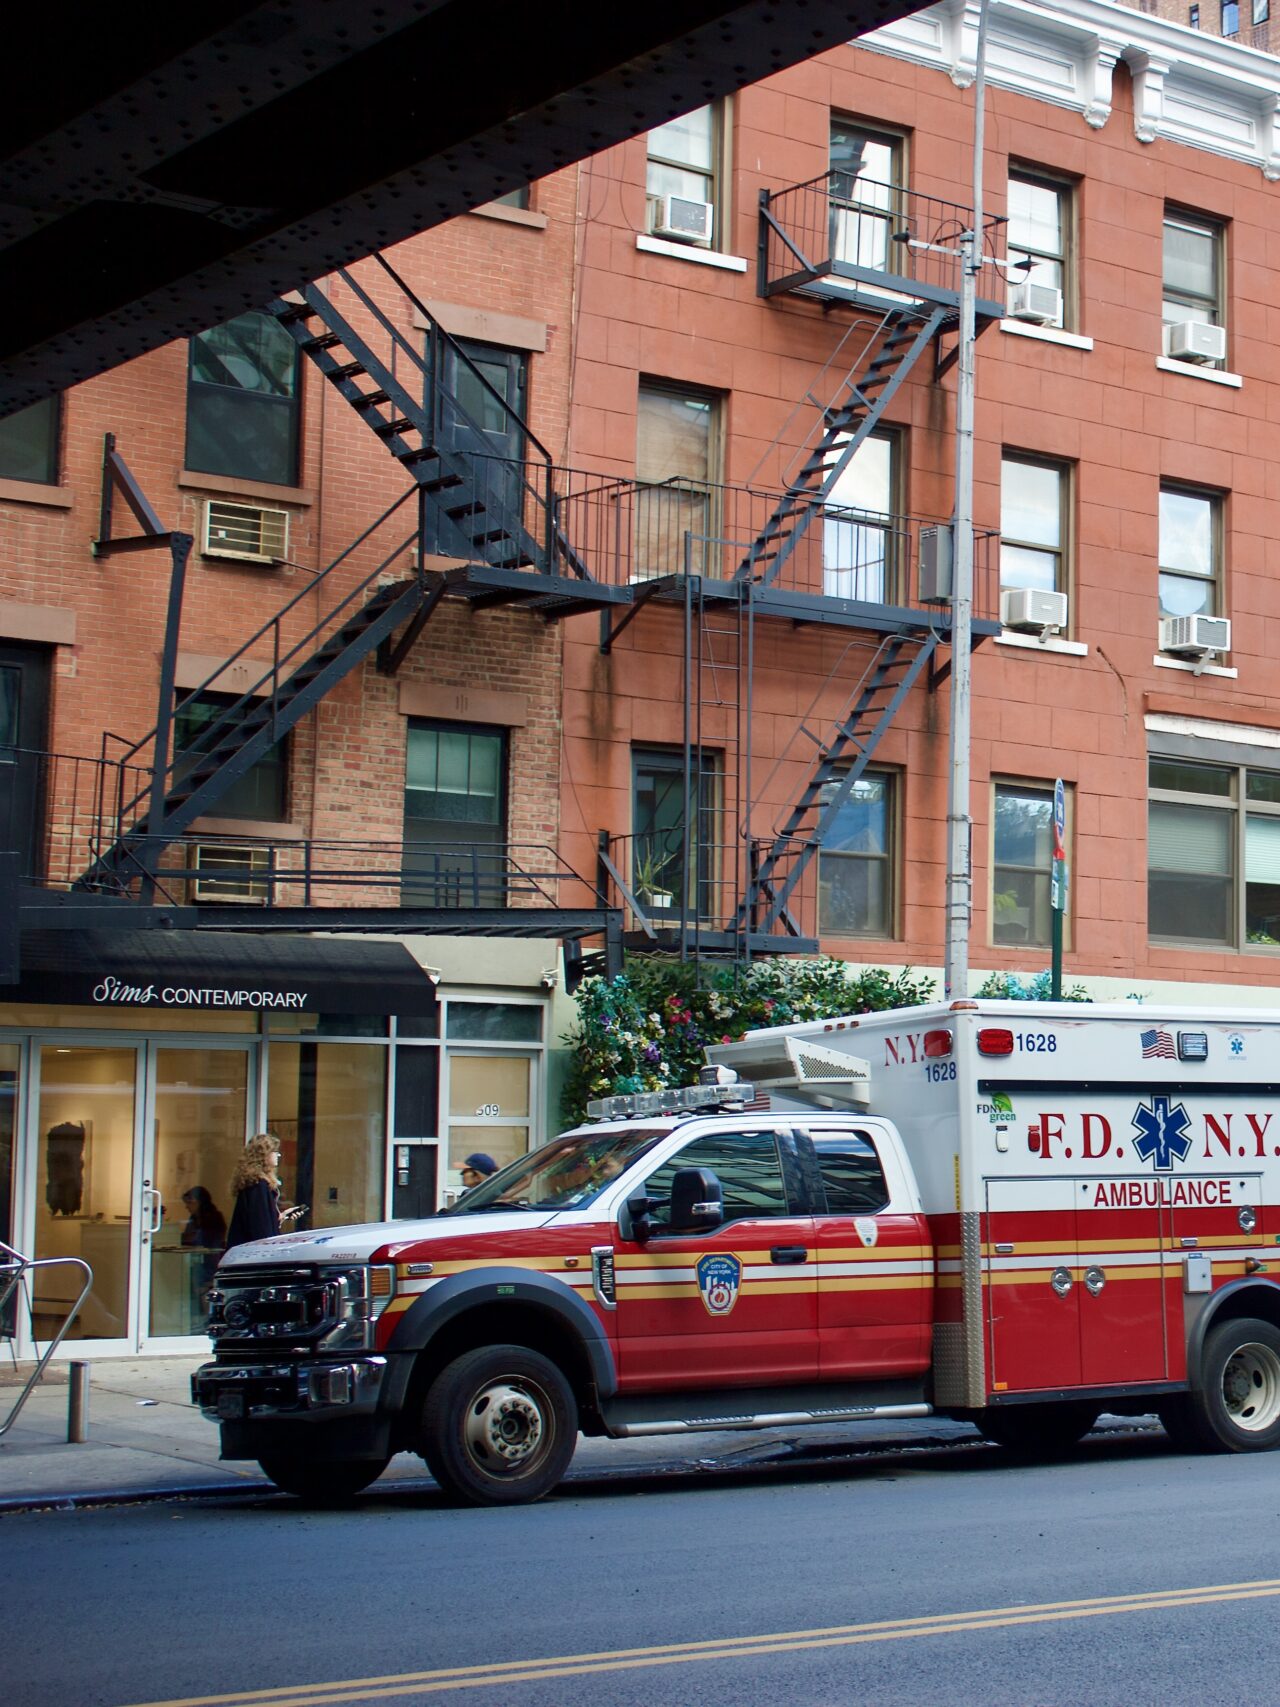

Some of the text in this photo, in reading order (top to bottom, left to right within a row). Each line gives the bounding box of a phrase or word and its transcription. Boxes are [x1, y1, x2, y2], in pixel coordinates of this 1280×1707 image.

[93, 976, 308, 1008] Sims CONTEMPORARY
[884, 1033, 925, 1067] N.Y.
[1016, 1033, 1057, 1053] 1628
[925, 1061, 957, 1083] 1628
[976, 1104, 1003, 1114] FDNY
[989, 1111, 1016, 1123] green
[1038, 1113, 1124, 1159] F.D.
[1093, 1180, 1233, 1208] AMBULANCE
